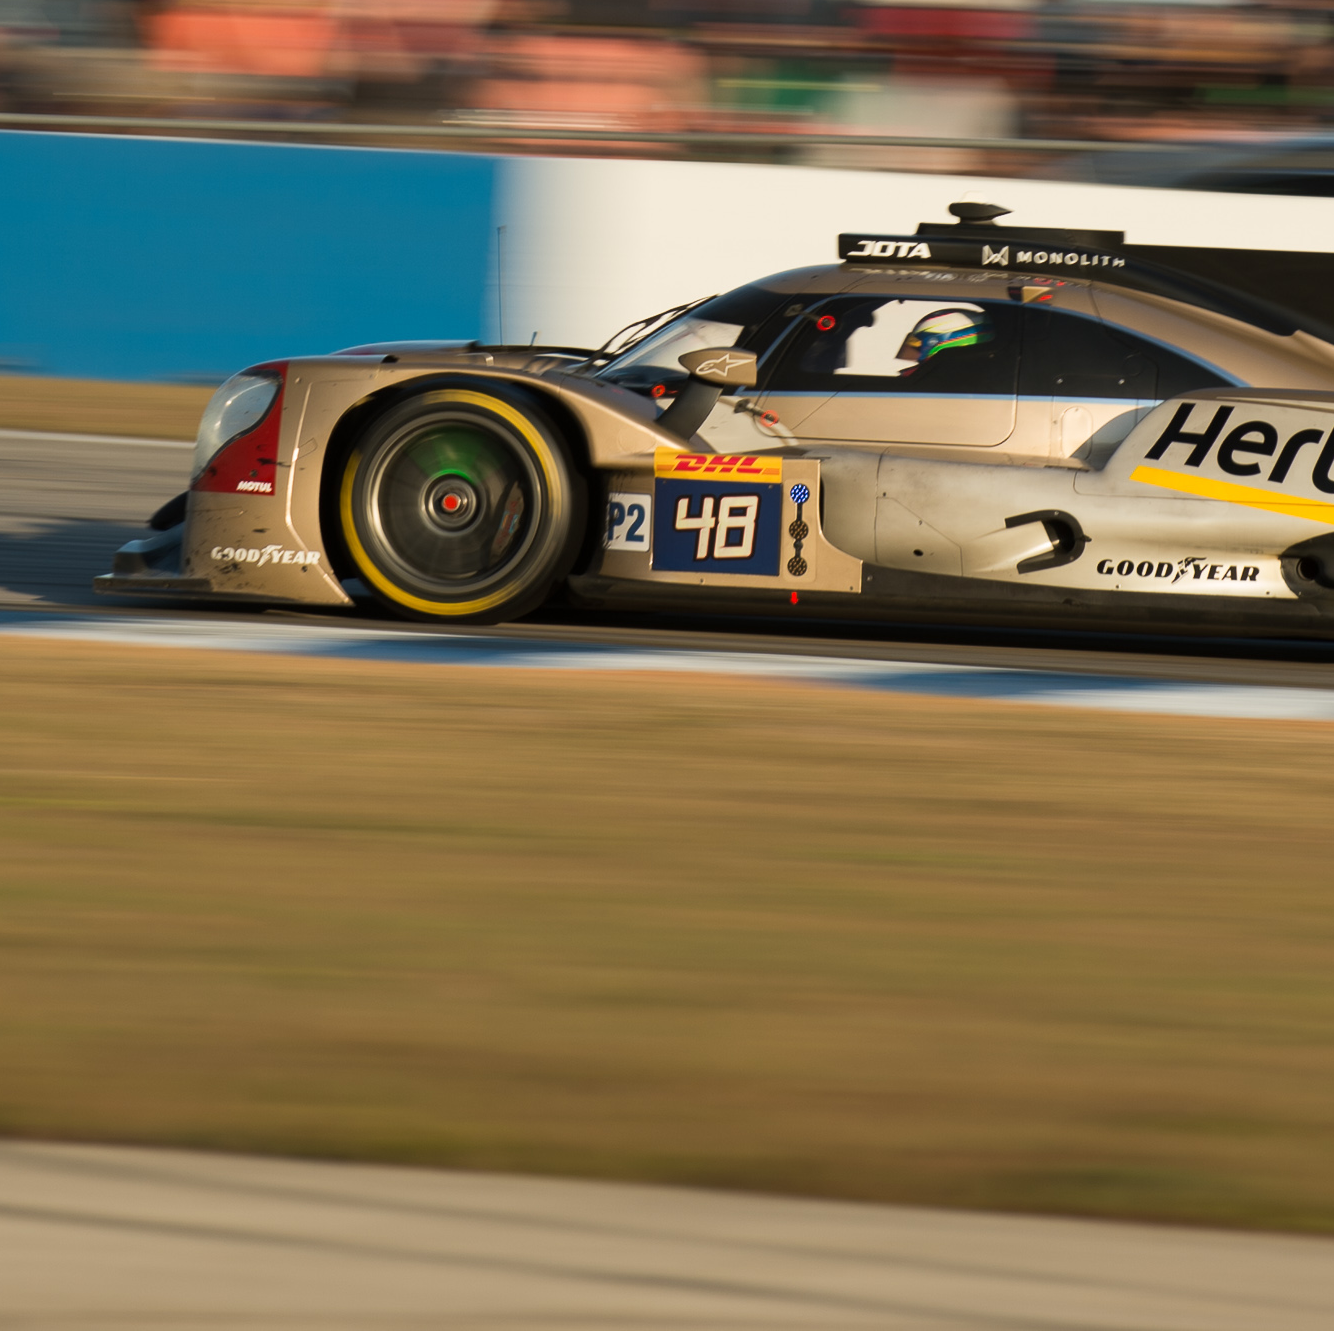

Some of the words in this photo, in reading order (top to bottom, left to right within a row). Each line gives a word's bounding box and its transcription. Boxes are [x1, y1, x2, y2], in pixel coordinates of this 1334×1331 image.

[846, 240, 932, 259] JOTA
[1016, 251, 1126, 268] MONOLITH
[672, 454, 765, 475] DHL
[235, 480, 273, 493] MOTUL
[674, 494, 760, 561] 48
